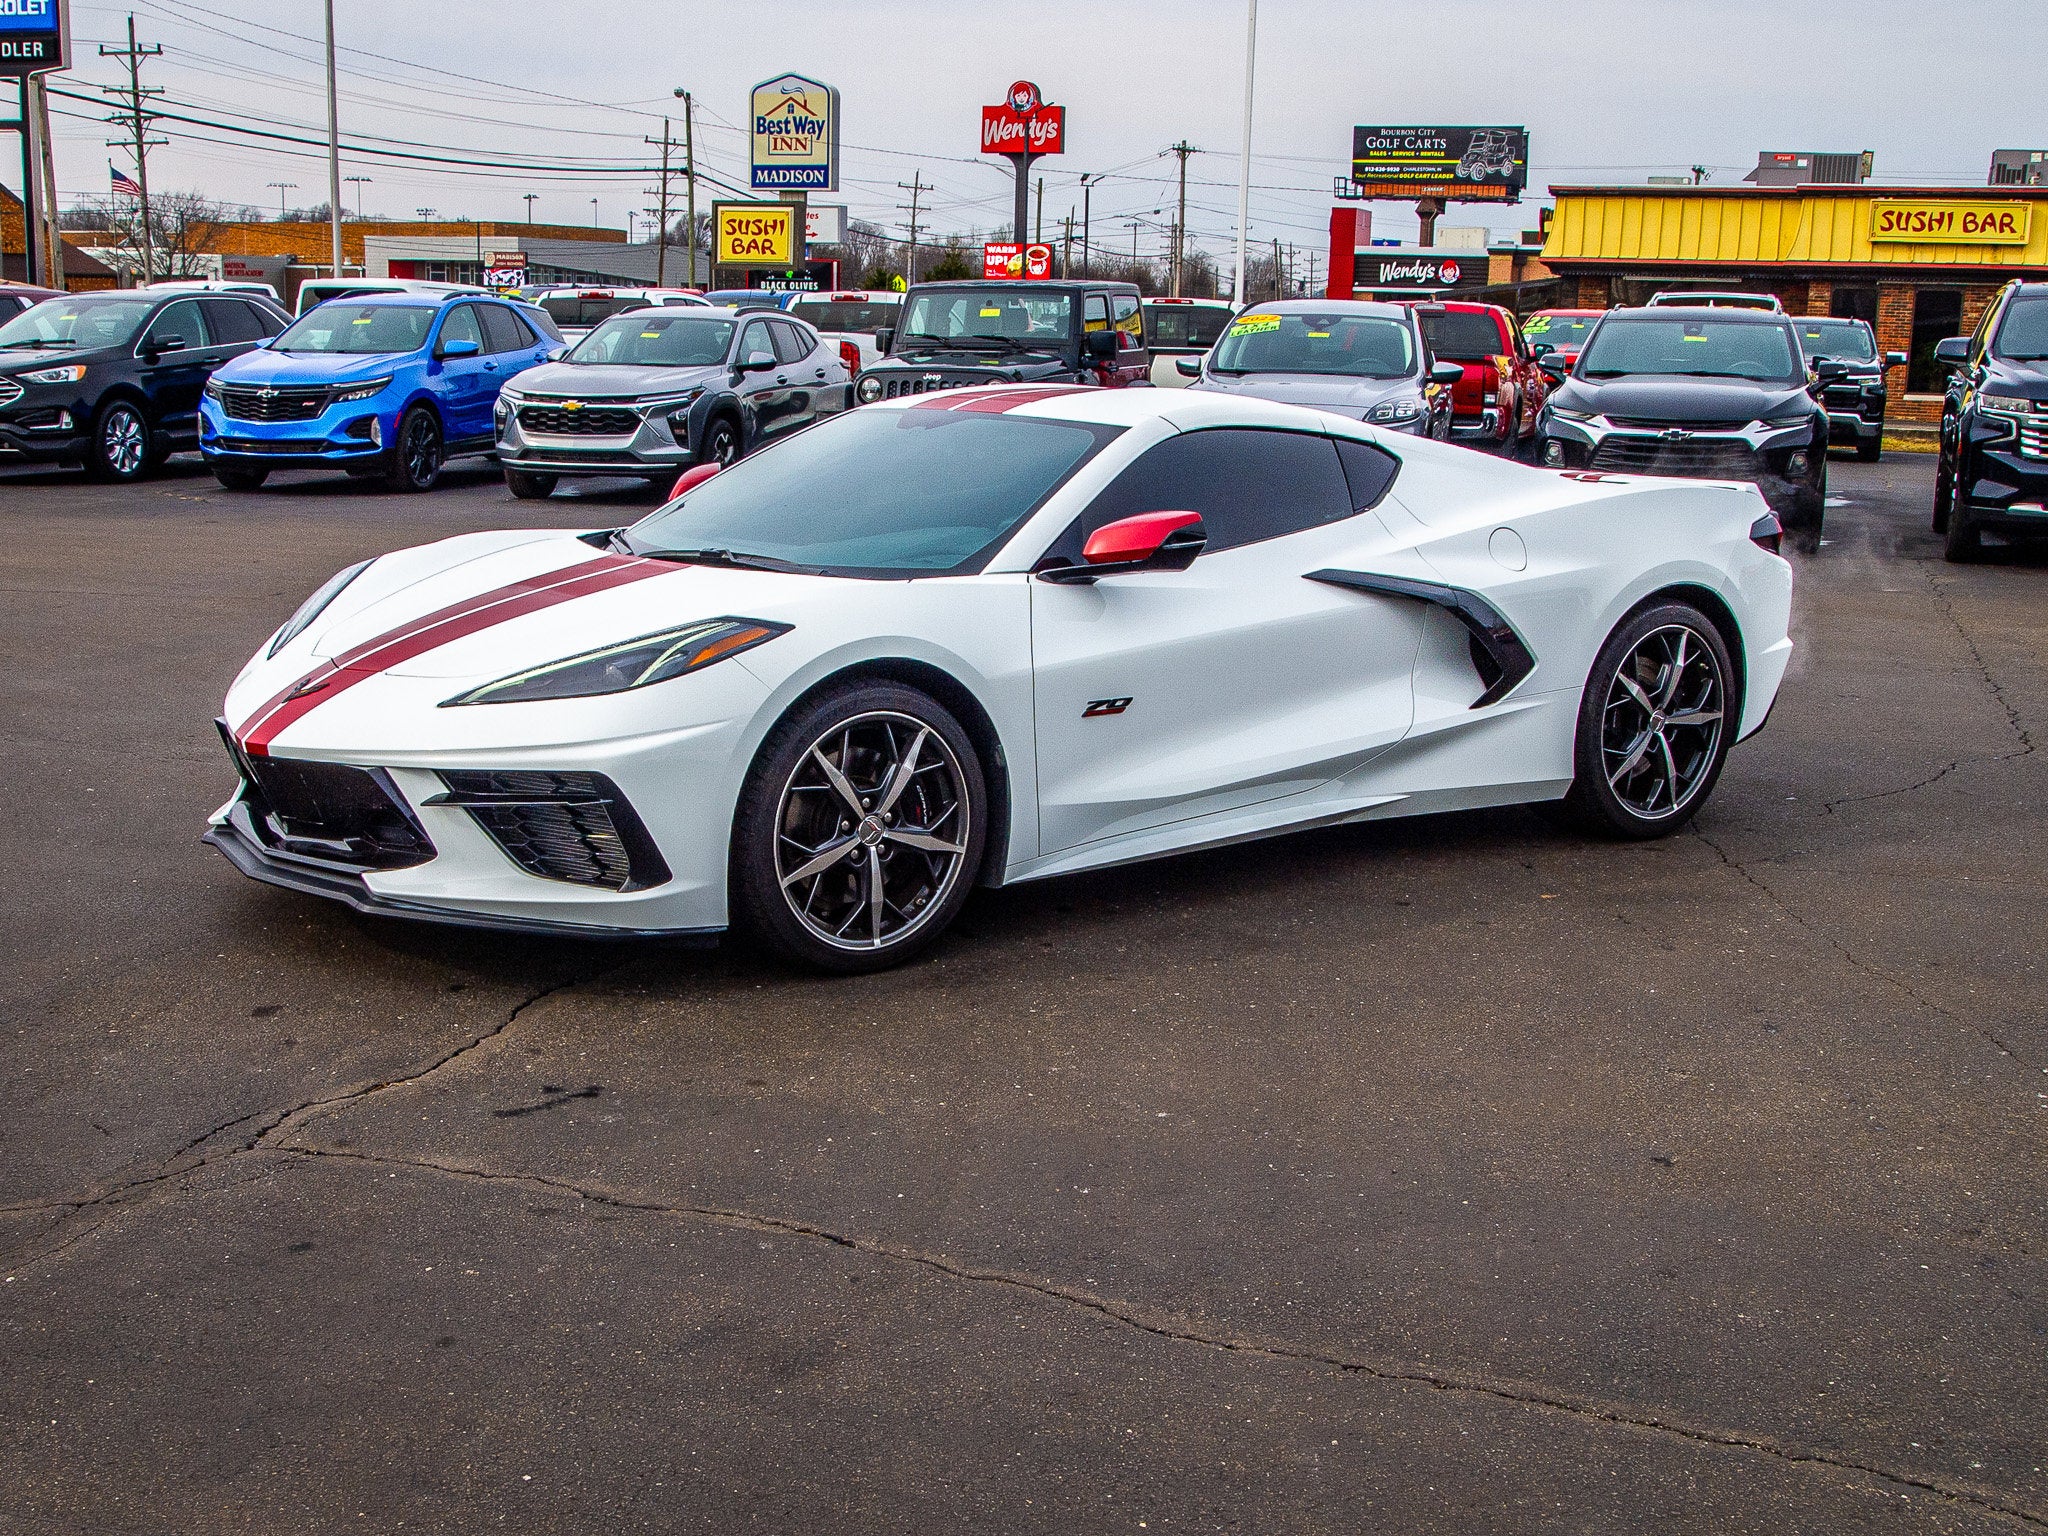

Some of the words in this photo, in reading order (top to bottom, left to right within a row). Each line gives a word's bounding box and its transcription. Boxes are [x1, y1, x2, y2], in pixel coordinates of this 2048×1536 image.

[1, 41, 44, 57] DLER
[756, 116, 790, 135] Best
[792, 116, 826, 140] Way
[772, 137, 808, 151] INN
[1366, 136, 1400, 148] GOLF
[1404, 136, 1447, 148] CARTS
[756, 170, 824, 184] MADISON
[725, 218, 785, 236] SUSHI
[1880, 210, 1954, 232] SUSHI
[1962, 212, 2017, 234] BAR
[732, 238, 776, 255] BAR
[986, 255, 1008, 266] UP!
[1380, 260, 1436, 283] Wendy's
[760, 281, 786, 290] BLACK
[789, 282, 819, 290] OLIVES
